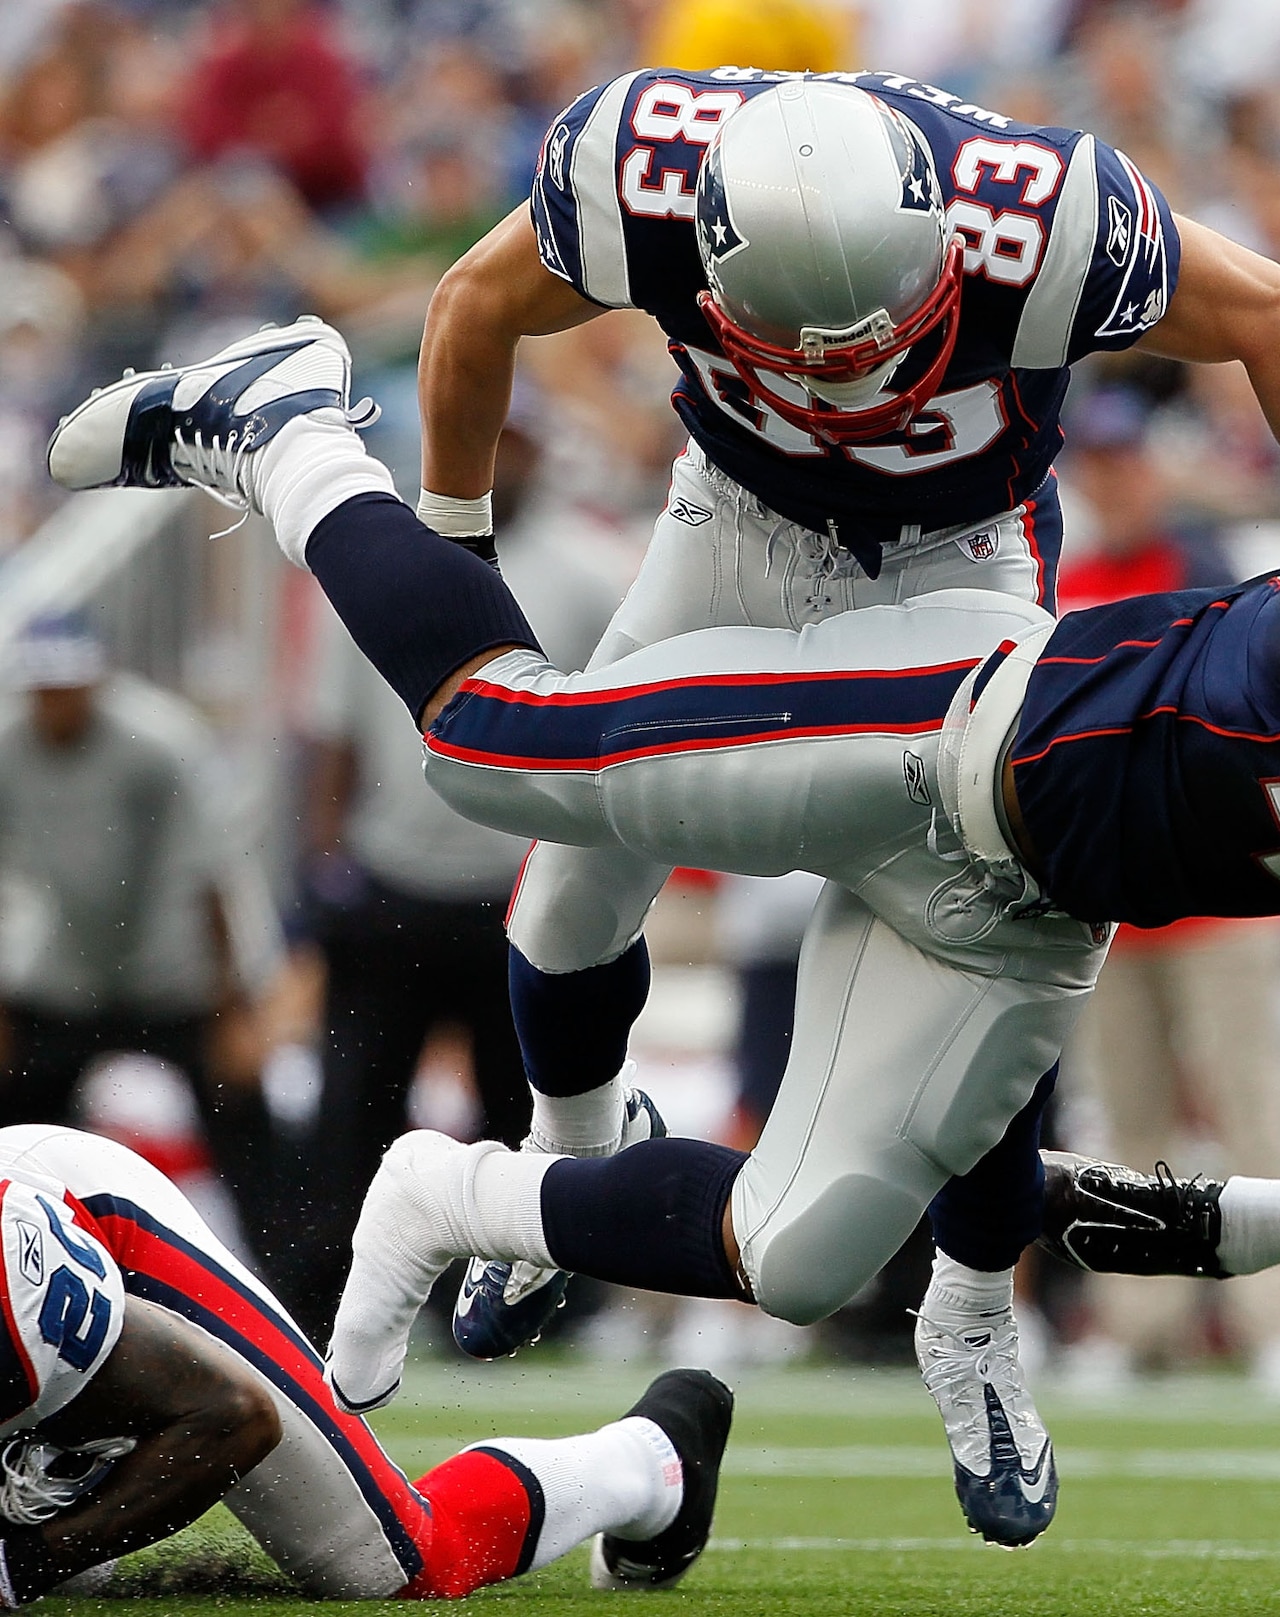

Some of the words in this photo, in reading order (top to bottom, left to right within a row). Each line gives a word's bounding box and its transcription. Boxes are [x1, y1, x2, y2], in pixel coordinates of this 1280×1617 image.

[618, 80, 747, 222] 83
[945, 135, 1066, 288] 83
[822, 321, 873, 345] Riddell
